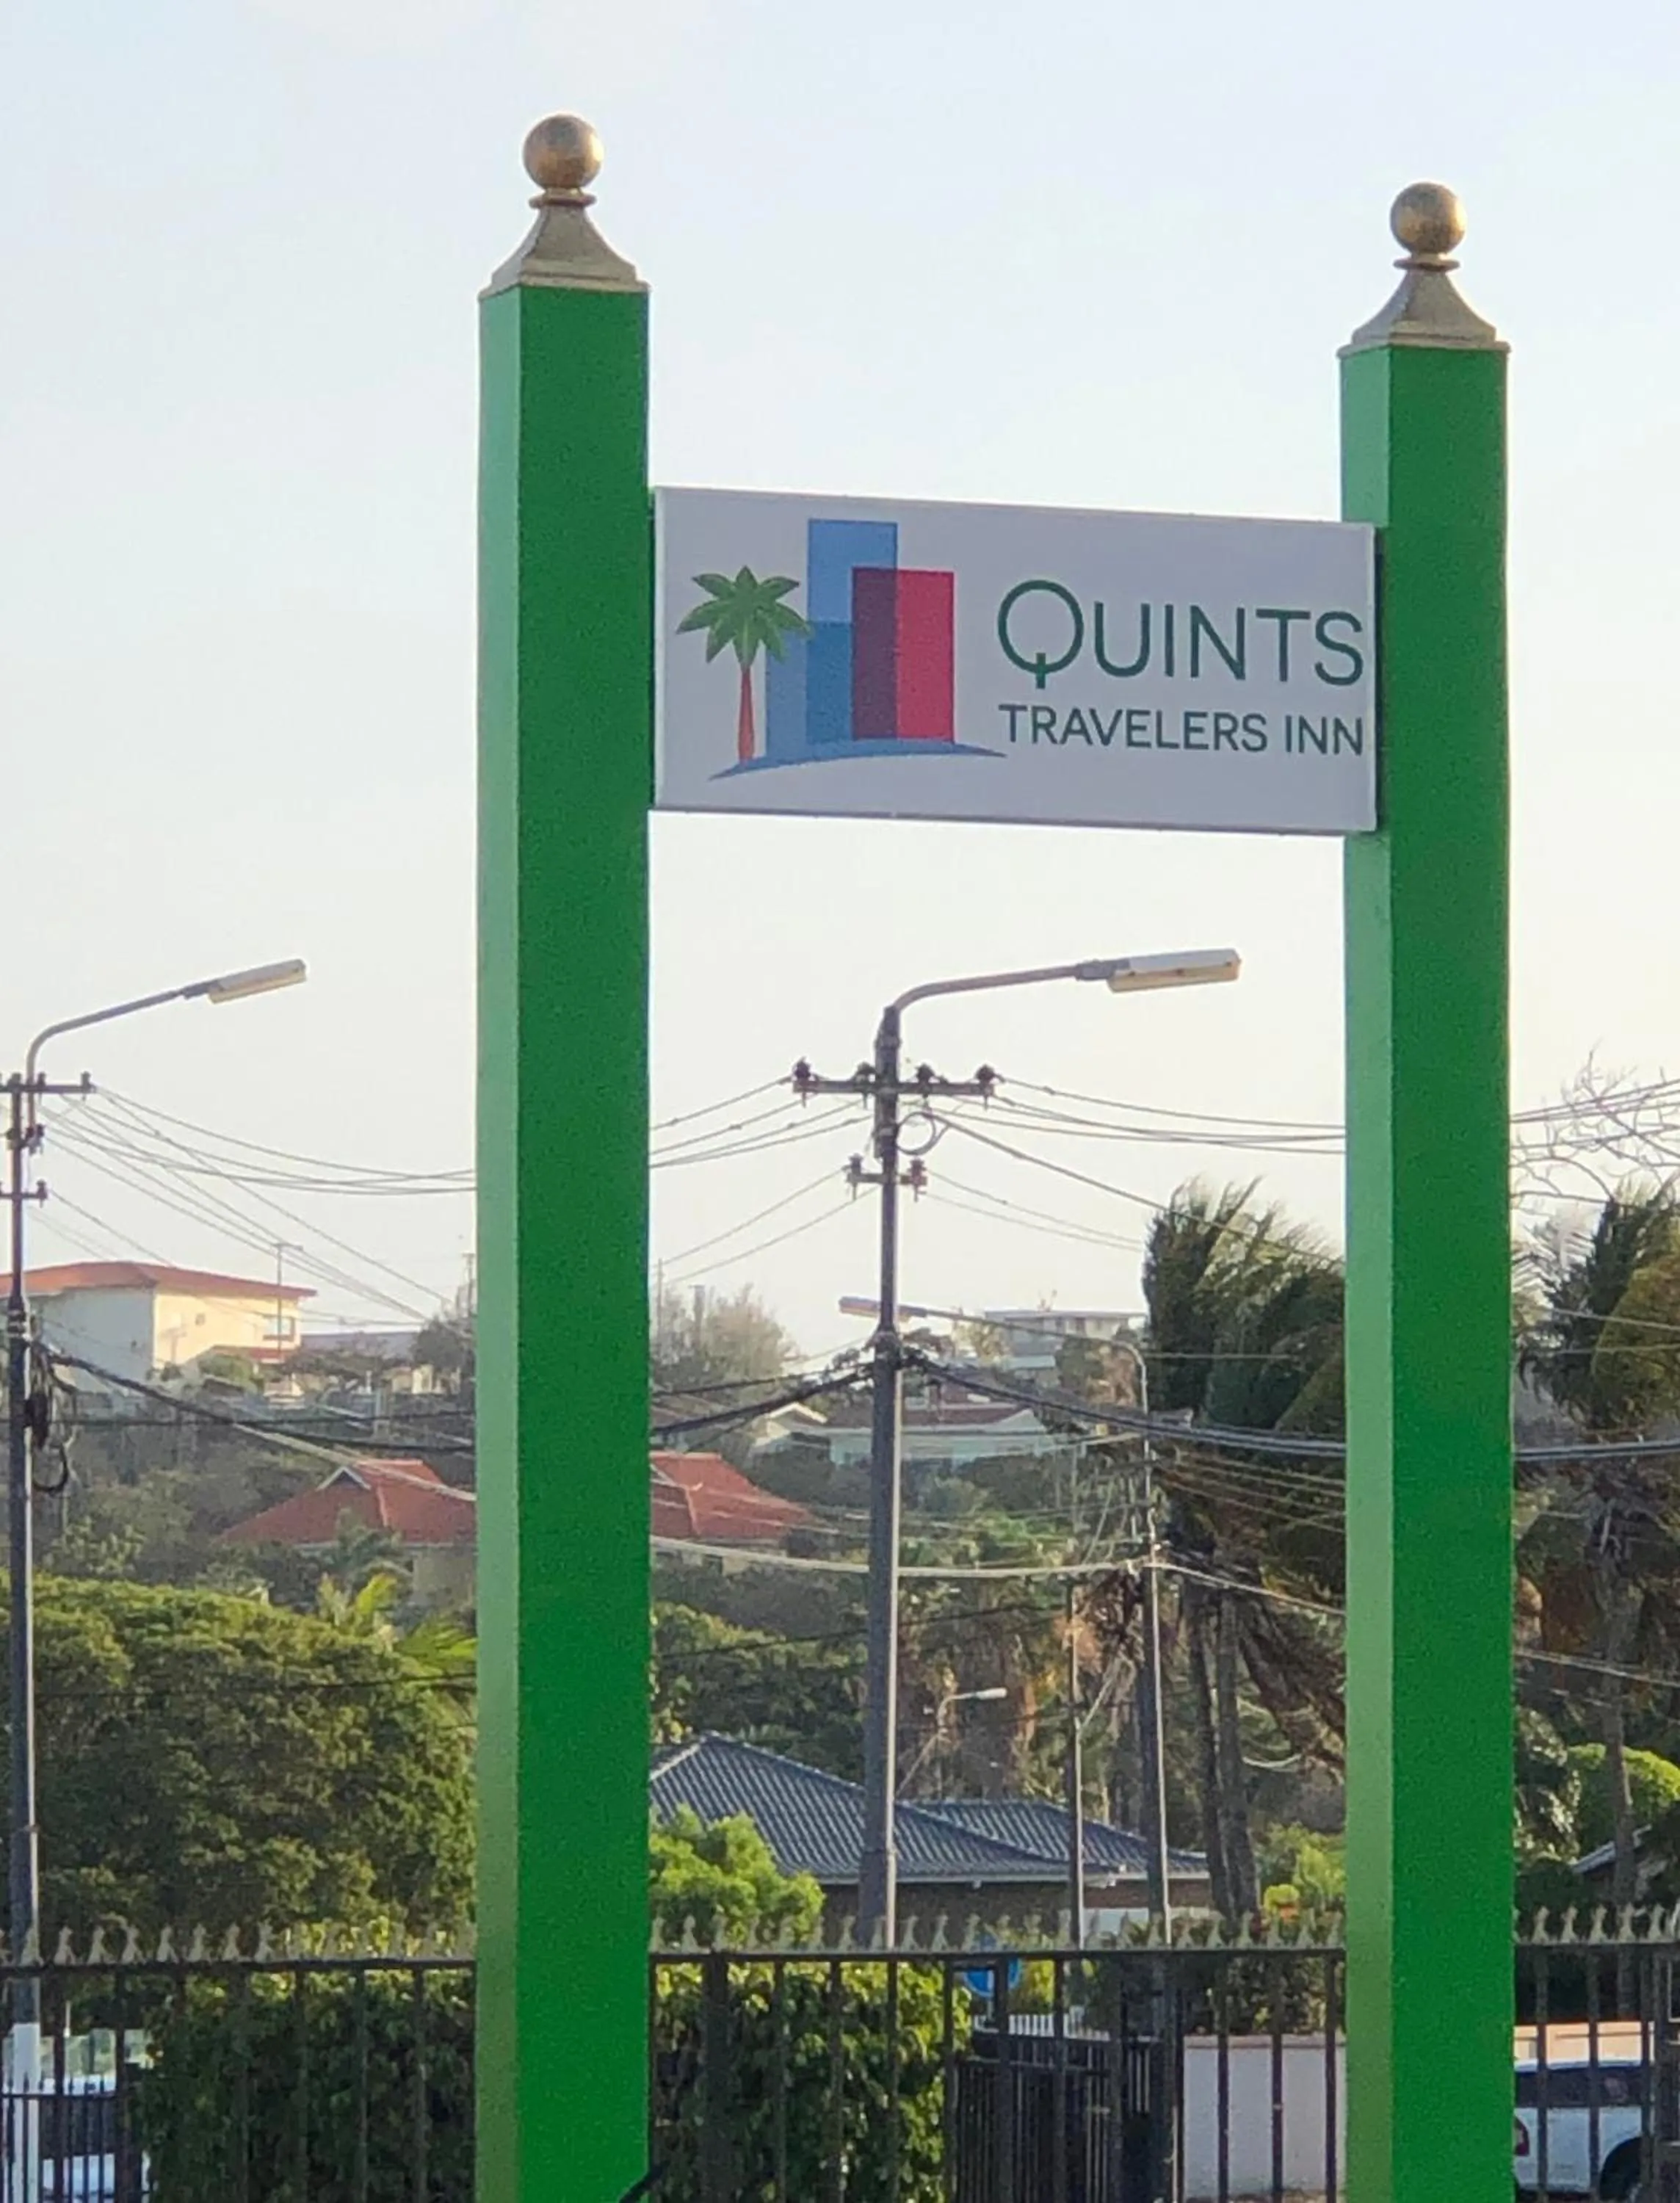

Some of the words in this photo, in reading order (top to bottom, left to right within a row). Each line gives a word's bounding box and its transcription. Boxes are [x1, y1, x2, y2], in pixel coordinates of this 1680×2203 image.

[997, 579, 1364, 689] QUINTS
[998, 703, 1268, 753] TRAVELERS
[1285, 715, 1363, 756] INN
